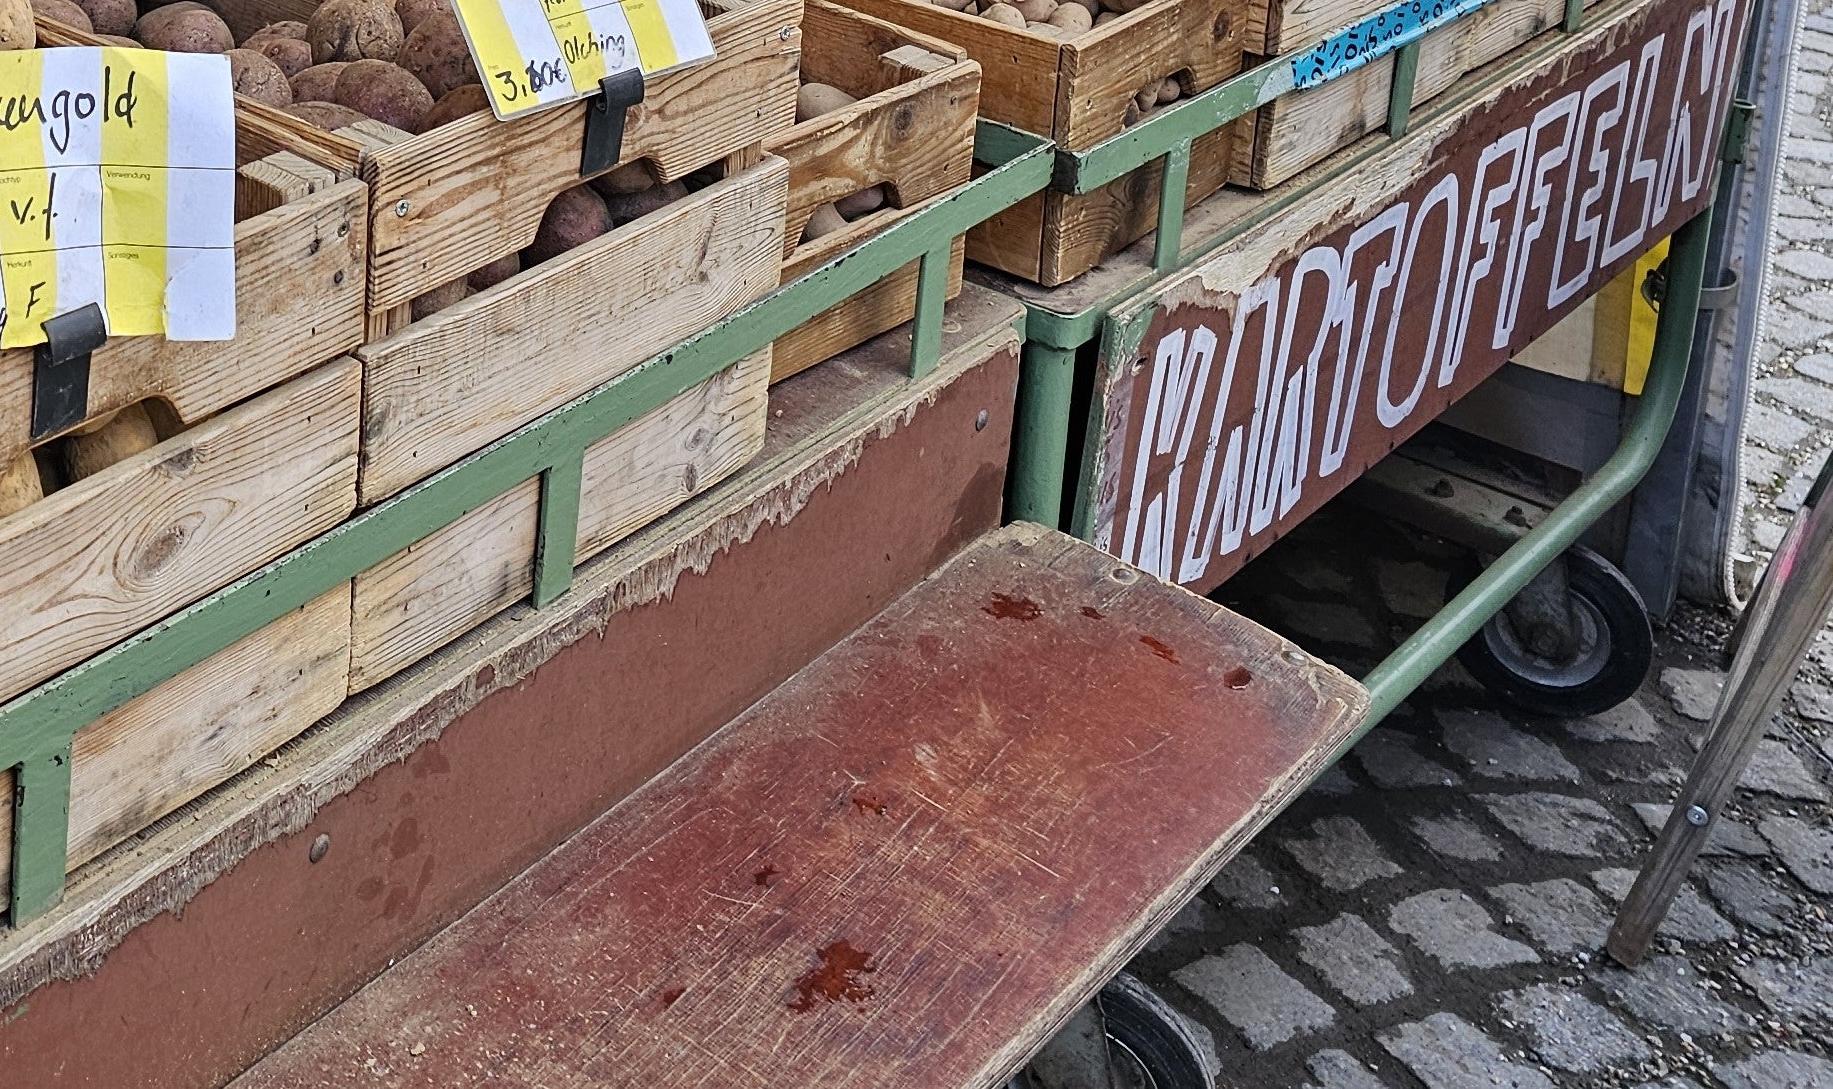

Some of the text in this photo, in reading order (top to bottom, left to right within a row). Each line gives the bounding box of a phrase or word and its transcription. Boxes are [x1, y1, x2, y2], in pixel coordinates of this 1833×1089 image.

[563, 31, 627, 69] Olching
[105, 169, 152, 182] Verwendung
[25, 281, 47, 320] F
